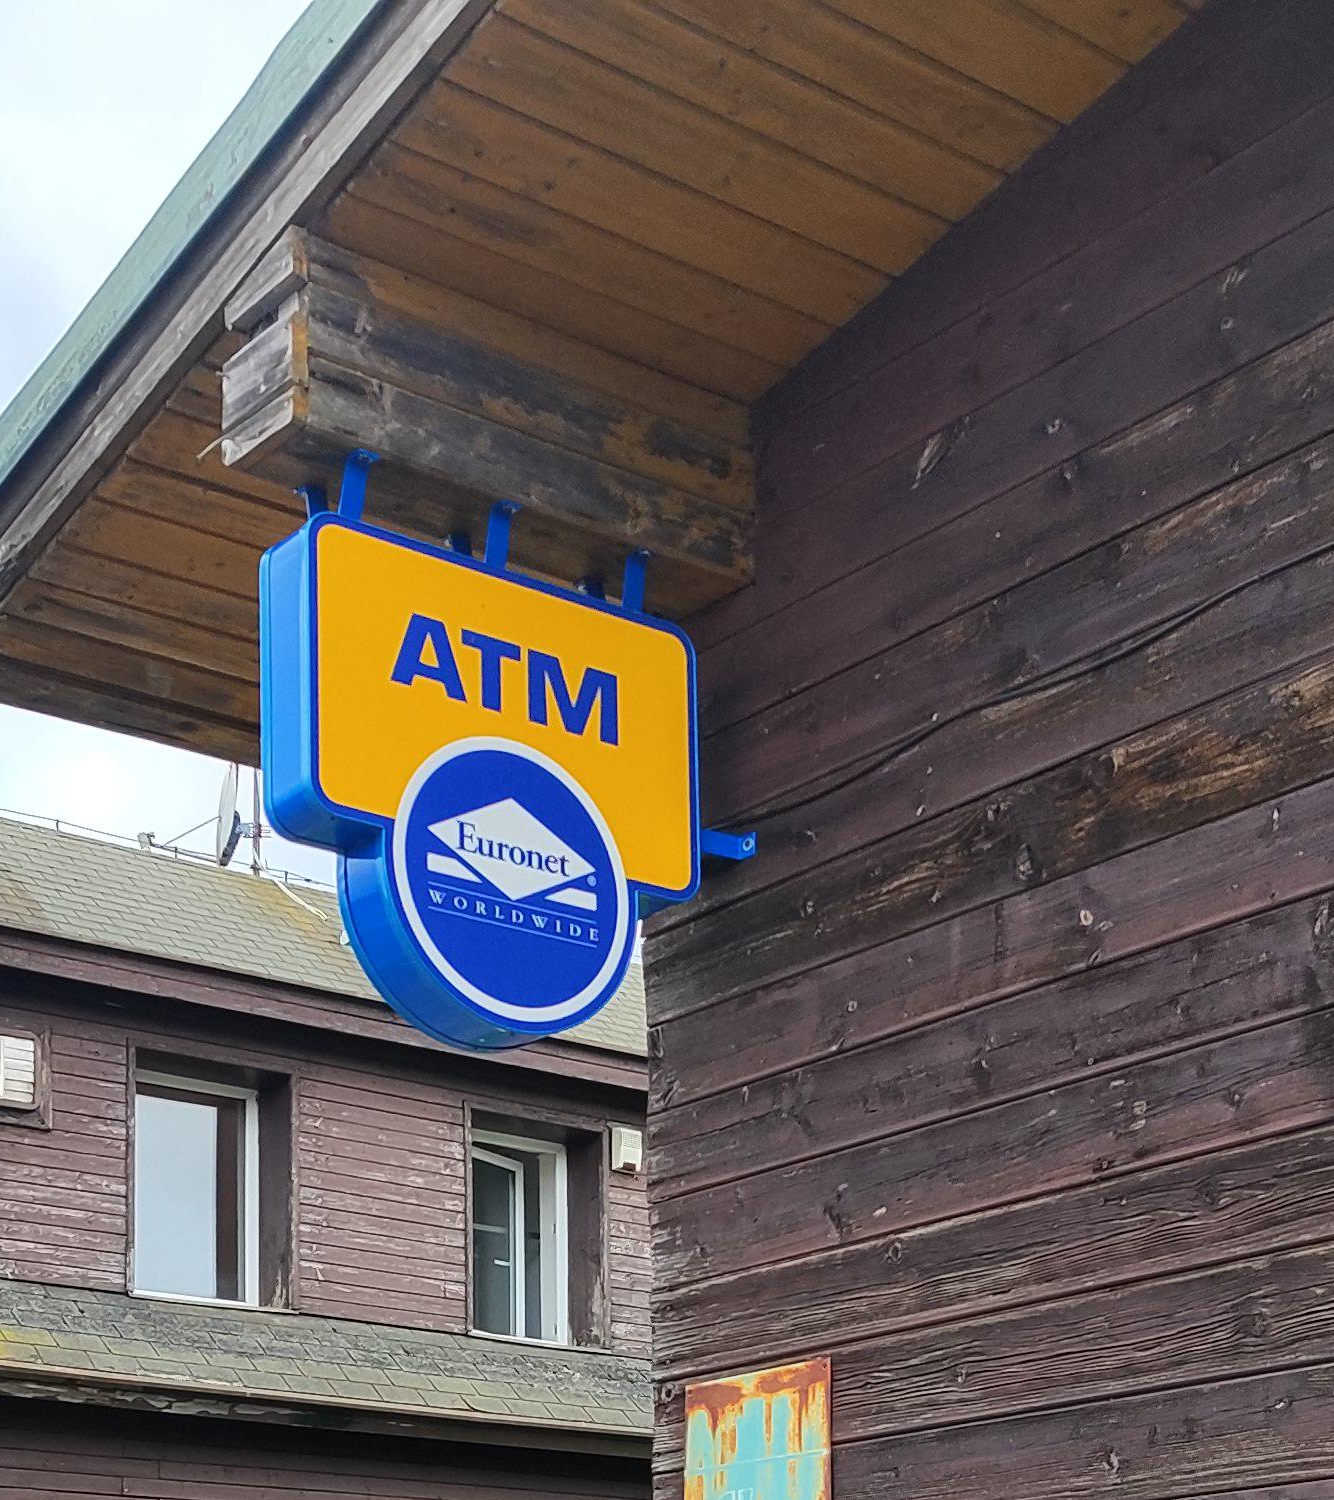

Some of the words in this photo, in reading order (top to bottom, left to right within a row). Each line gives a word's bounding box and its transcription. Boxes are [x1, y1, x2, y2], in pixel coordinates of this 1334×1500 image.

[389, 612, 619, 747] ATM
[456, 820, 570, 877] Euronet
[428, 888, 599, 942] WORLDWIDE
